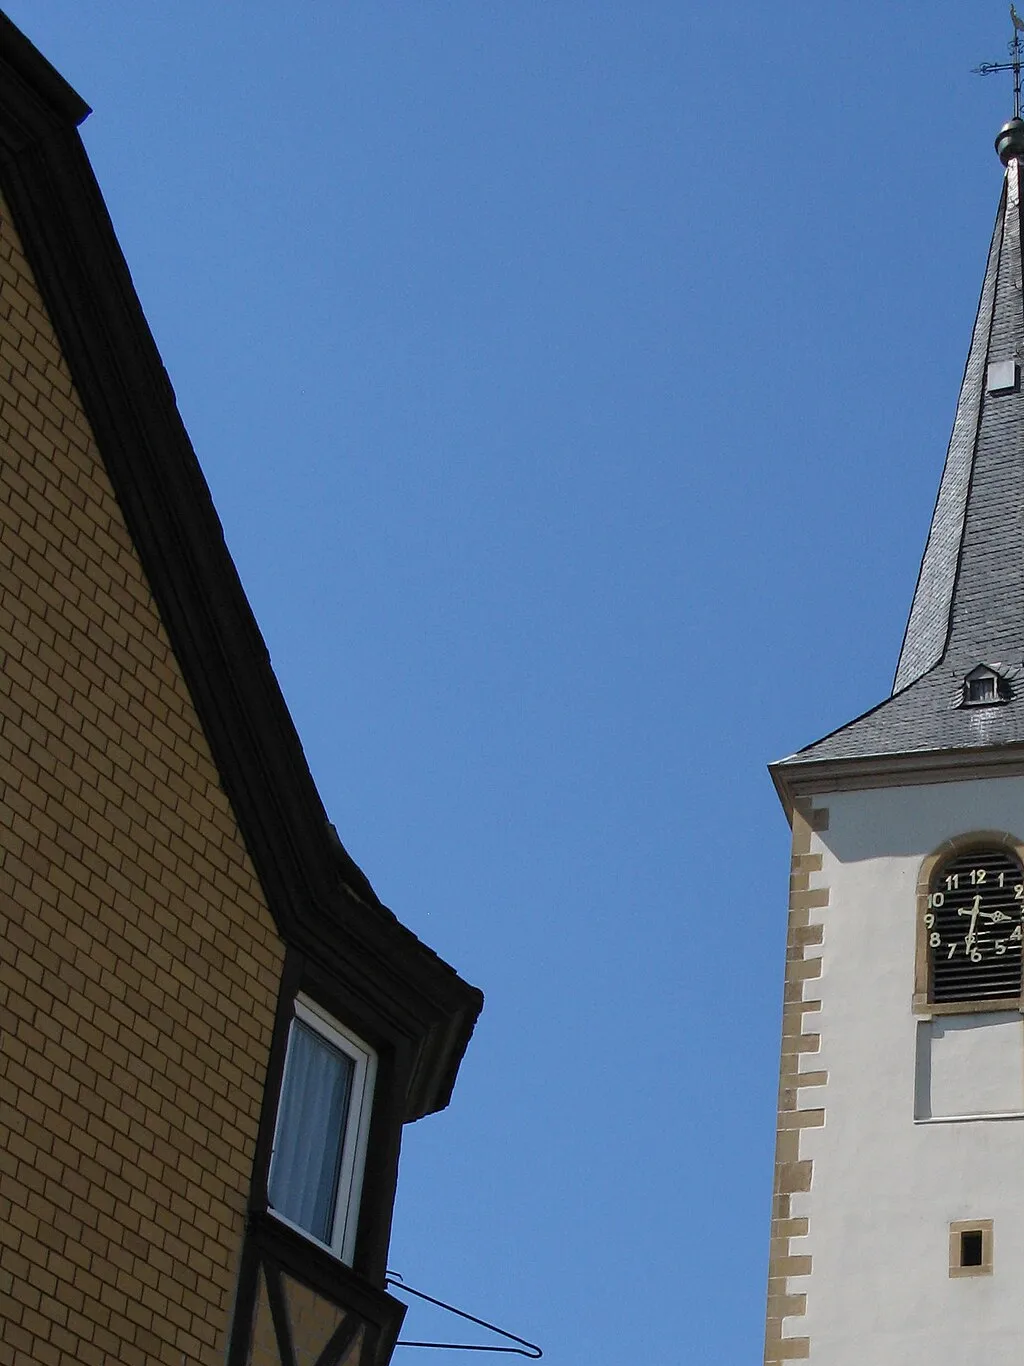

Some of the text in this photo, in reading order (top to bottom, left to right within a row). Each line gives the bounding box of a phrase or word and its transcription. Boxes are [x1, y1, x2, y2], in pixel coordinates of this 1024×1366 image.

[945, 874, 959, 891] 11
[969, 869, 986, 885] 12
[997, 872, 1005, 888] 1
[927, 892, 945, 908] 10
[1013, 884, 1024, 900] 2
[923, 914, 935, 929] 9
[929, 932, 941, 948] 8
[1010, 925, 1023, 941] 4
[947, 943, 958, 959] 7
[970, 947, 983, 963] 6
[994, 940, 1006, 955] 5
